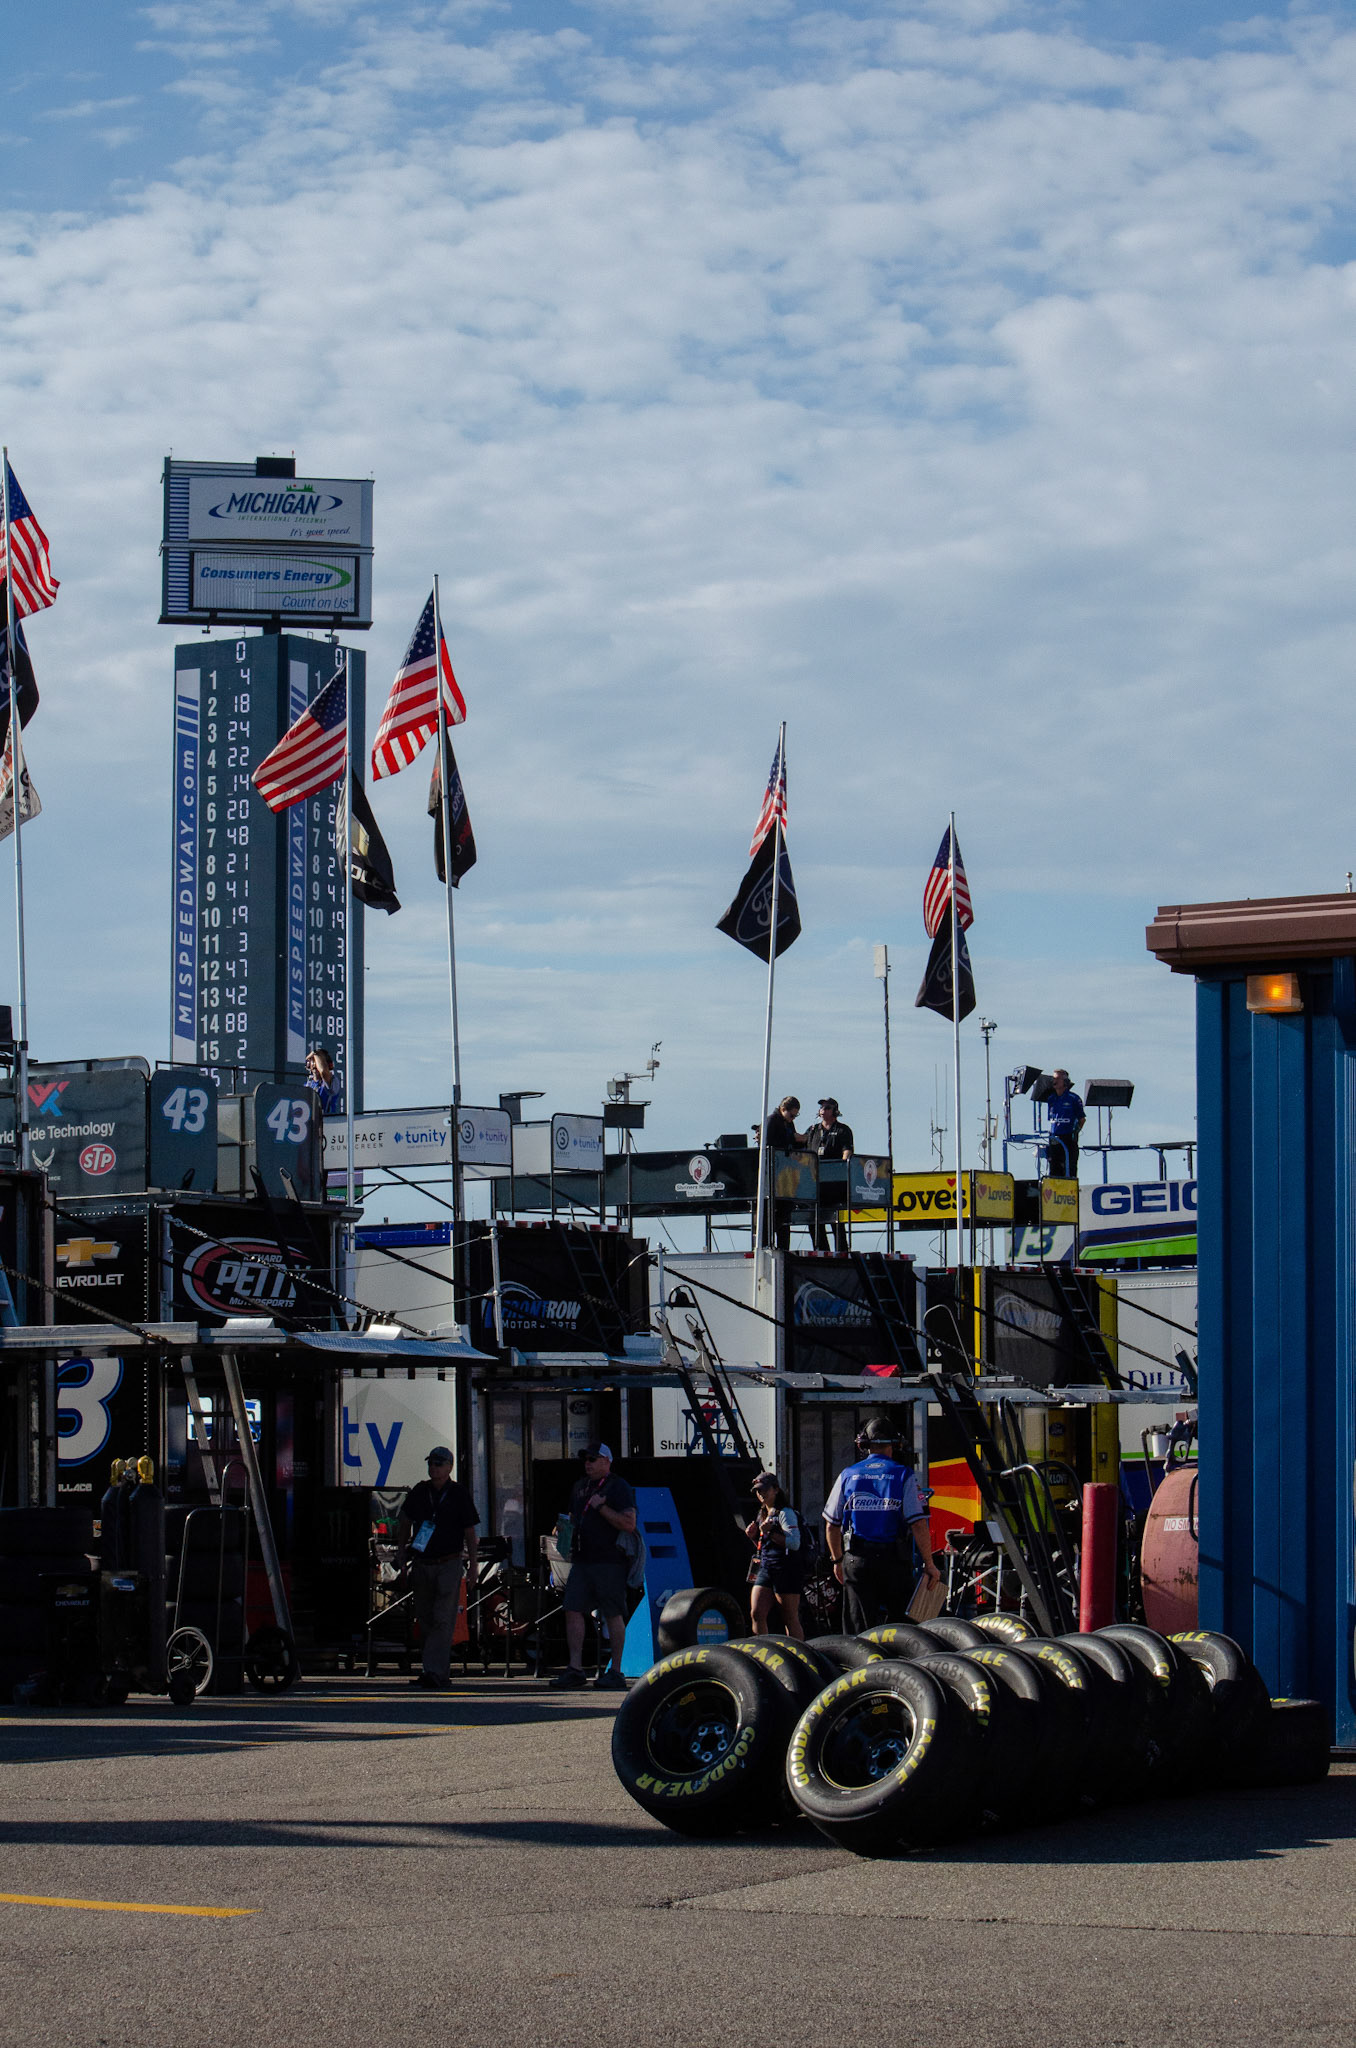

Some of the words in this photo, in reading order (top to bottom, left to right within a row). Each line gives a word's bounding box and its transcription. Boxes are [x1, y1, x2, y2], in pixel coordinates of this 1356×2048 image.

[226, 492, 320, 515] MICHIGAN
[238, 515, 290, 523] INTERNATIONAL
[294, 516, 327, 524] SPEEDWAY
[306, 529, 324, 539] your
[201, 566, 281, 580] Consumers
[284, 570, 333, 584] Energy
[282, 596, 316, 609] Count
[318, 600, 331, 609] on
[236, 640, 246, 661] 0
[334, 648, 343, 668] 0
[209, 670, 217, 690] 1
[240, 668, 250, 686] 4
[314, 670, 321, 690] 1
[208, 697, 217, 717] 2
[234, 693, 250, 714] 18
[208, 723, 217, 743] 3
[228, 720, 250, 741] 24
[207, 750, 216, 769] 4
[227, 746, 250, 767] 22
[207, 776, 216, 796] 5
[233, 774, 249, 792] 14
[206, 802, 216, 822] 6
[227, 799, 249, 820] 20
[313, 802, 320, 822] 6
[206, 828, 216, 848] 7
[226, 826, 248, 846] 48
[312, 828, 320, 848] 7
[206, 854, 216, 875] 8
[226, 853, 248, 874] 21
[312, 855, 320, 875] 8
[178, 750, 195, 1024] MISPEEDWAY.com
[206, 881, 216, 901] 9
[226, 880, 248, 898] 41
[312, 882, 320, 900] 9
[328, 884, 345, 904] 41
[201, 907, 220, 928] 10
[232, 905, 248, 925] 19
[292, 807, 304, 1020] MISPEEDWAY.
[309, 908, 323, 928] 10
[332, 911, 344, 930] 19
[202, 934, 220, 954] 11
[239, 932, 248, 952] 3
[310, 934, 323, 954] 11
[337, 938, 344, 958] 3
[200, 960, 220, 981] 12
[226, 958, 248, 978] 47
[308, 960, 323, 981] 12
[328, 964, 344, 982] 47
[200, 987, 220, 1008] 13
[226, 985, 248, 1006] 42
[308, 987, 323, 1008] 13
[328, 990, 344, 1010] 42
[200, 1013, 220, 1034] 14
[226, 1012, 248, 1033] 88
[308, 1013, 323, 1034] 14
[328, 1016, 344, 1036] 88
[200, 1040, 220, 1062] 15
[237, 1039, 246, 1059] 2
[336, 1044, 344, 1064] 2
[161, 1086, 210, 1133] 43
[266, 1098, 312, 1144] 43
[0, 1130, 14, 1144] rld
[27, 1127, 46, 1142] ide
[47, 1121, 116, 1139] Technology
[331, 1132, 384, 1144] SUFACE
[406, 1130, 447, 1147] tunity
[485, 1130, 508, 1146] tunity
[330, 1142, 384, 1151] SUNCREEN
[578, 1138, 601, 1153] tunity
[83, 1147, 112, 1172] STP
[1008, 1226, 1058, 1258] 13
[56, 1273, 124, 1288] EVROLET
[58, 1483, 92, 1492] LLACE
[1166, 1520, 1176, 1530] NO
[646, 1650, 710, 1686] EAGLE
[1038, 1646, 1082, 1688] EAGLE
[791, 1668, 868, 1788] GOODYEAR
[636, 1726, 756, 1797] GOODYEAR
[895, 1718, 936, 1784] EAGLE
